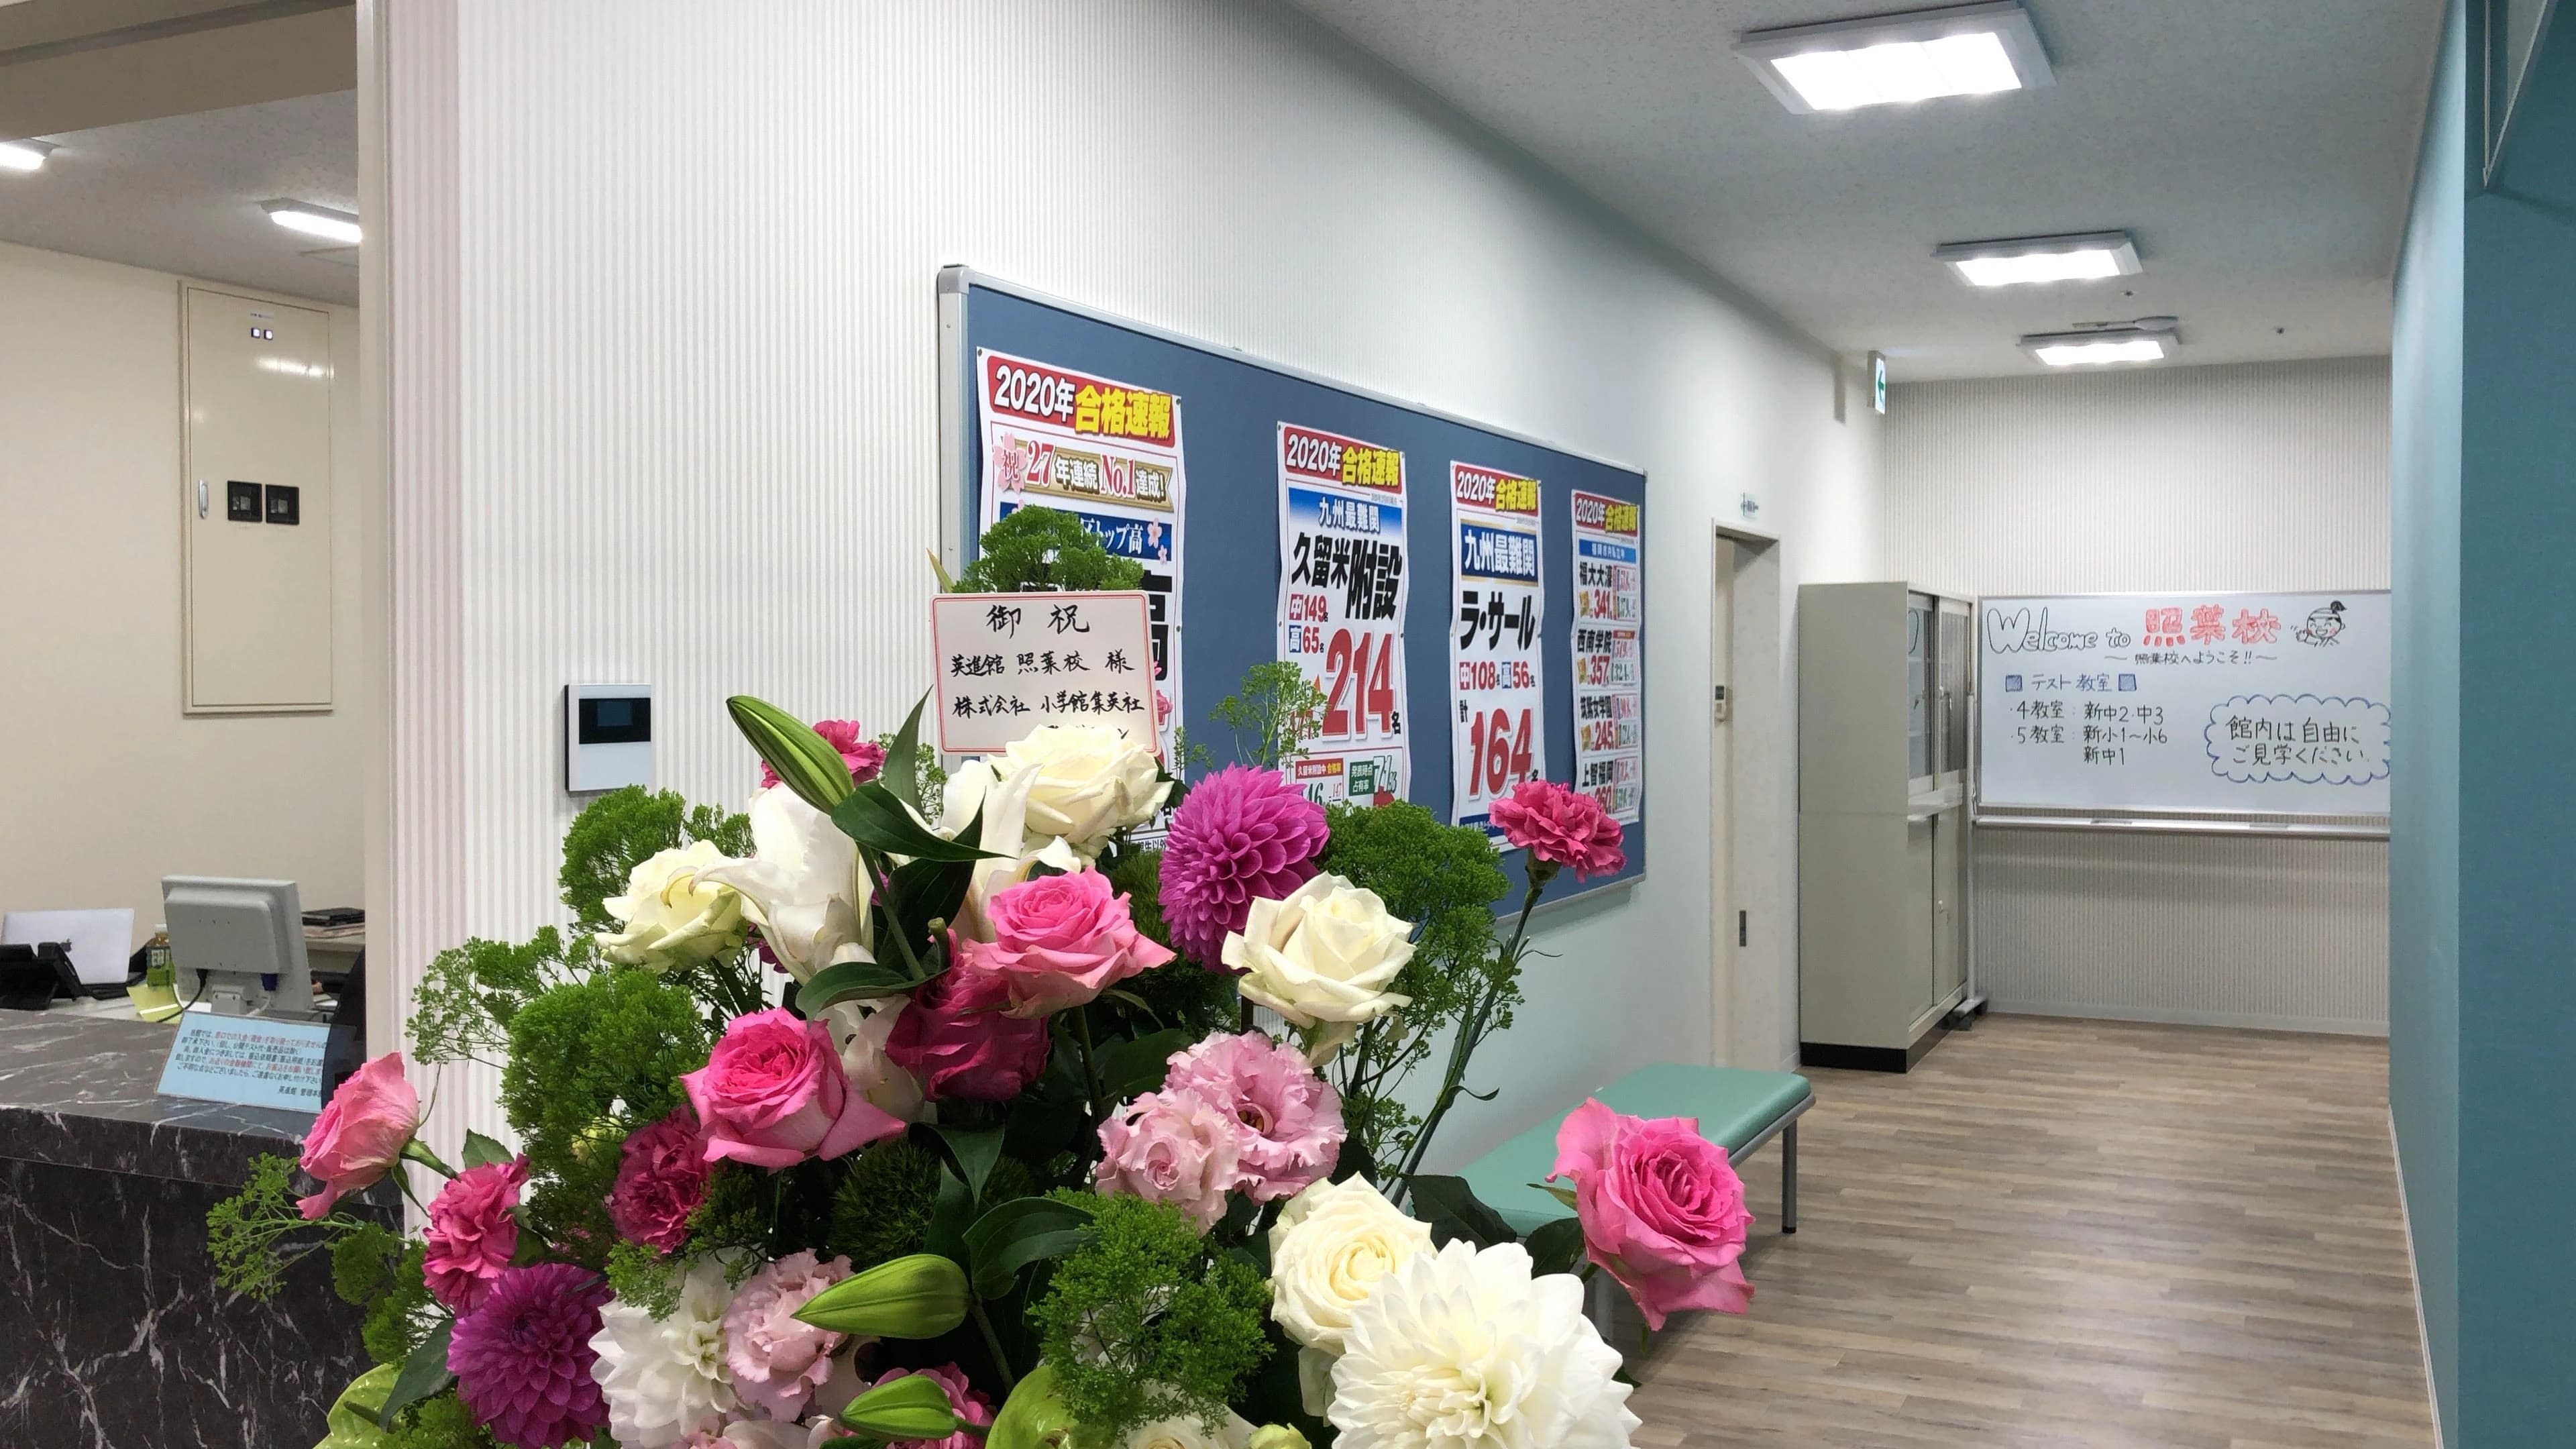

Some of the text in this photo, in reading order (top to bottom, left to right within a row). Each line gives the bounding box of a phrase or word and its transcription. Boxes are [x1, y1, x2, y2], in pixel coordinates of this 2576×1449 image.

[994, 364, 1173, 439] 2020年合格速報
[1286, 434, 1399, 486] 2020年合格速報
[1319, 497, 1380, 533] 九州最難関
[1464, 529, 1535, 576] 九州最難関
[985, 604, 1090, 639] 御 祝
[1460, 590, 1535, 651] ラ・サール
[1987, 604, 2281, 653] Welcome to 照葉校
[1578, 629, 1612, 653] 西南学院
[951, 649, 1135, 677] 英進館 照葉校 様
[952, 690, 1145, 718] 株式会社 小学館集英社
[2225, 714, 2359, 743] 館内は自由に
[2084, 745, 2125, 765] 新中1
